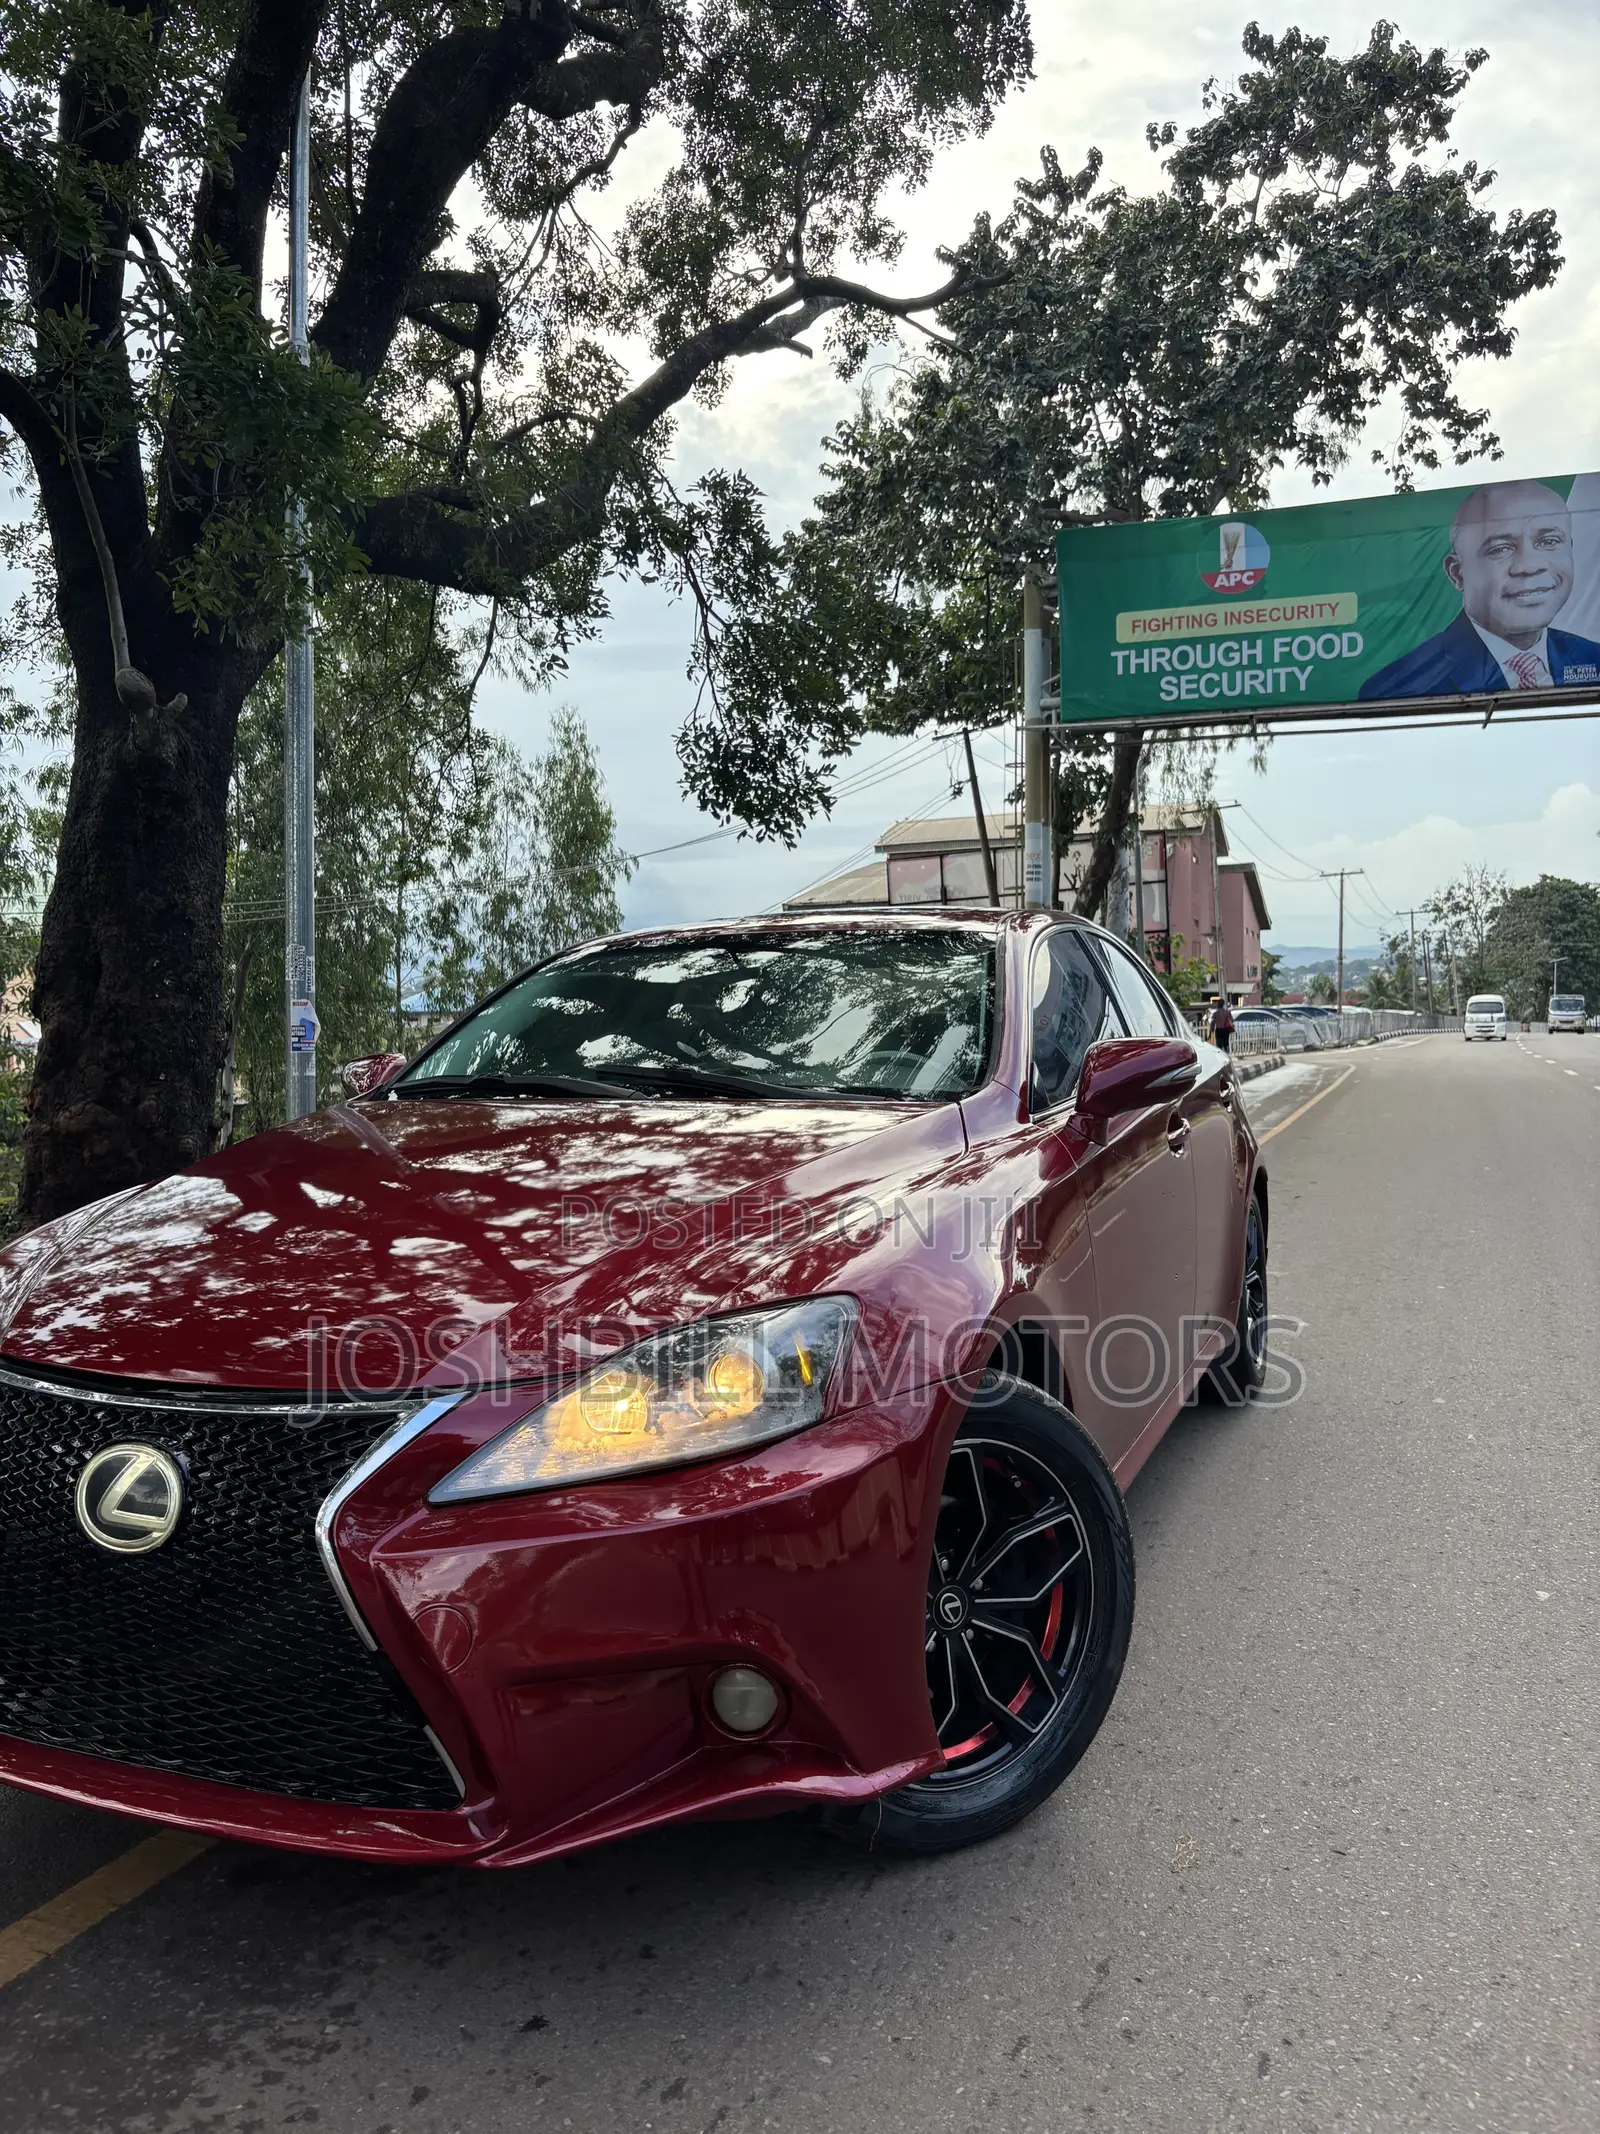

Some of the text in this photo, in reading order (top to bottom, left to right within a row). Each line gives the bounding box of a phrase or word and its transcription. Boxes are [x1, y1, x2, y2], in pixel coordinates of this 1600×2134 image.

[1213, 569, 1255, 588] APC
[1131, 602, 1340, 634] FIGHTING INSECURITY
[1111, 631, 1364, 676] THROUGH FOOD
[1159, 666, 1314, 701] SECURITY
